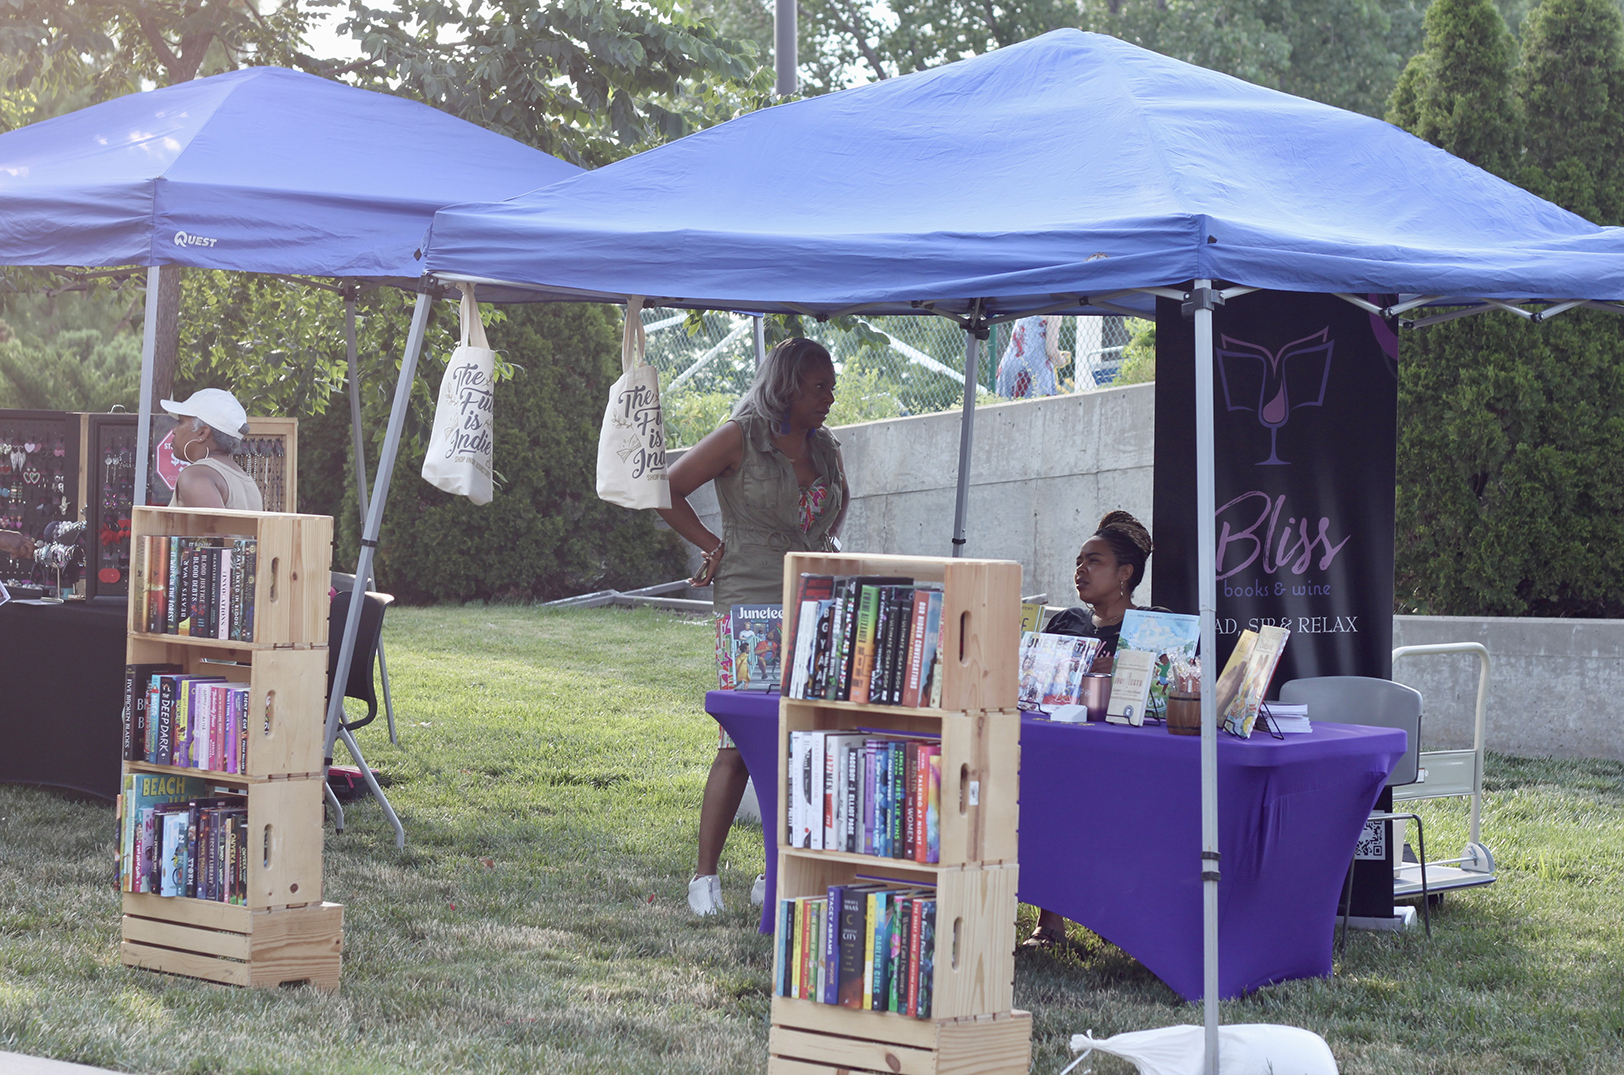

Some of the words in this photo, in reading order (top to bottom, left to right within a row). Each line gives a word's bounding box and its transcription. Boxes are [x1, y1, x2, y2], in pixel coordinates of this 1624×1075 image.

[174, 231, 217, 248] QUEST
[453, 363, 486, 395] The
[618, 385, 655, 418] The
[464, 410, 482, 431] is
[445, 428, 492, 459] Indie
[649, 429, 662, 448] is
[1215, 491, 1351, 580] Bliss
[1224, 579, 1268, 597] books
[1274, 581, 1286, 596] &
[1292, 580, 1331, 596] wine
[862, 592, 871, 612] KWAME
[918, 602, 926, 614] OUR
[833, 598, 843, 634] MADNESS
[916, 616, 924, 638] HIDDEN
[1280, 616, 1293, 631] &
[1297, 616, 1358, 634] RELAX
[858, 613, 870, 643] ALEXANDER
[910, 640, 922, 689] CONVERSATIONS
[161, 700, 170, 724] DEEP
[159, 725, 169, 752] DARK
[142, 777, 186, 796] BEACH
[917, 809, 922, 819] AT
[874, 935, 882, 968] DARLING
